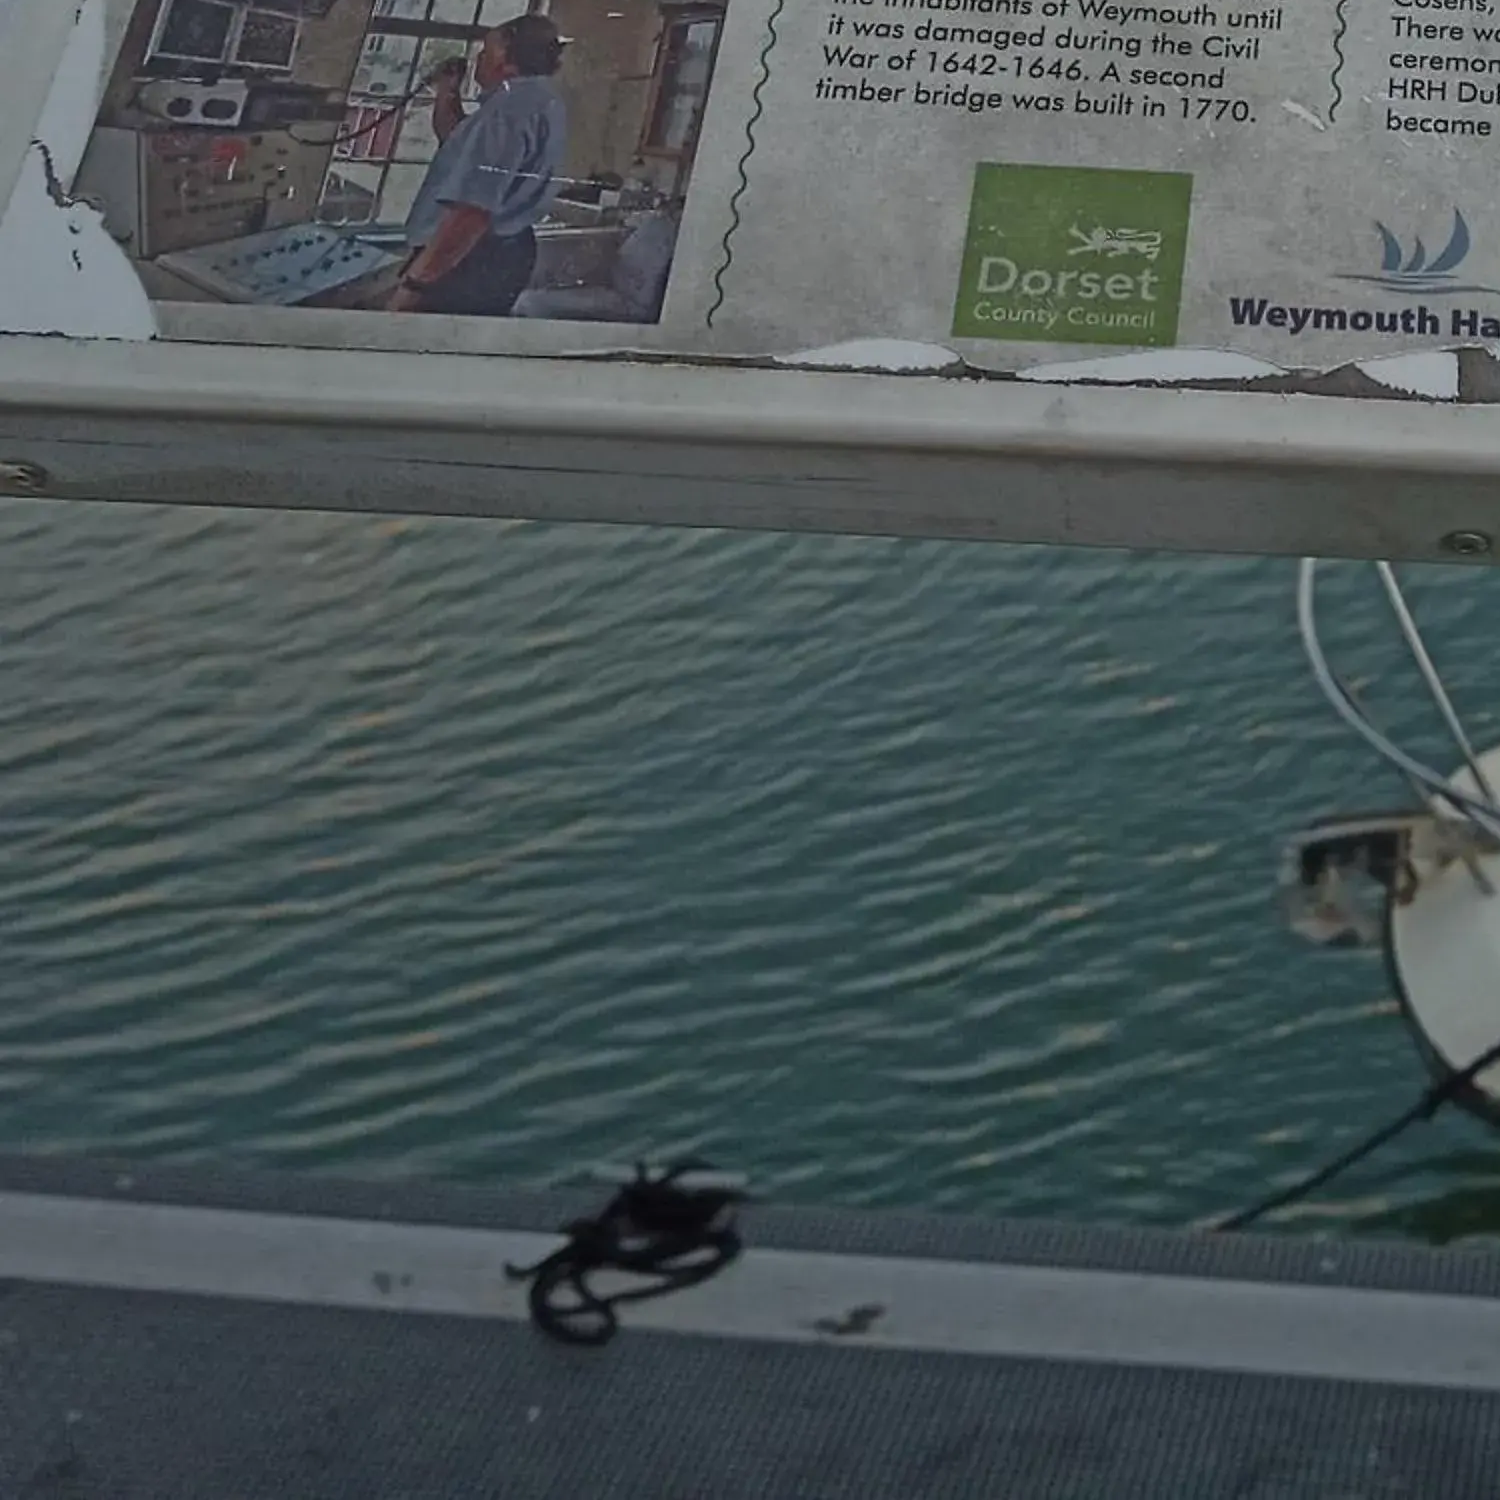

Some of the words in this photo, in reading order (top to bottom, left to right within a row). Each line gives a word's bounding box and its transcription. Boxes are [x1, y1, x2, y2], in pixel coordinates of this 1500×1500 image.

[827, 12, 845, 35] it
[851, 20, 905, 39] was
[913, 16, 1046, 51] damaged
[1054, 25, 1142, 58] during
[1150, 31, 1193, 56] the
[1201, 34, 1260, 60] Civil
[1385, 106, 1492, 136] became
[976, 256, 1160, 301] Dorset
[973, 301, 1059, 330] County
[1067, 307, 1155, 328] Council
[1230, 297, 1441, 336] Weymouth
